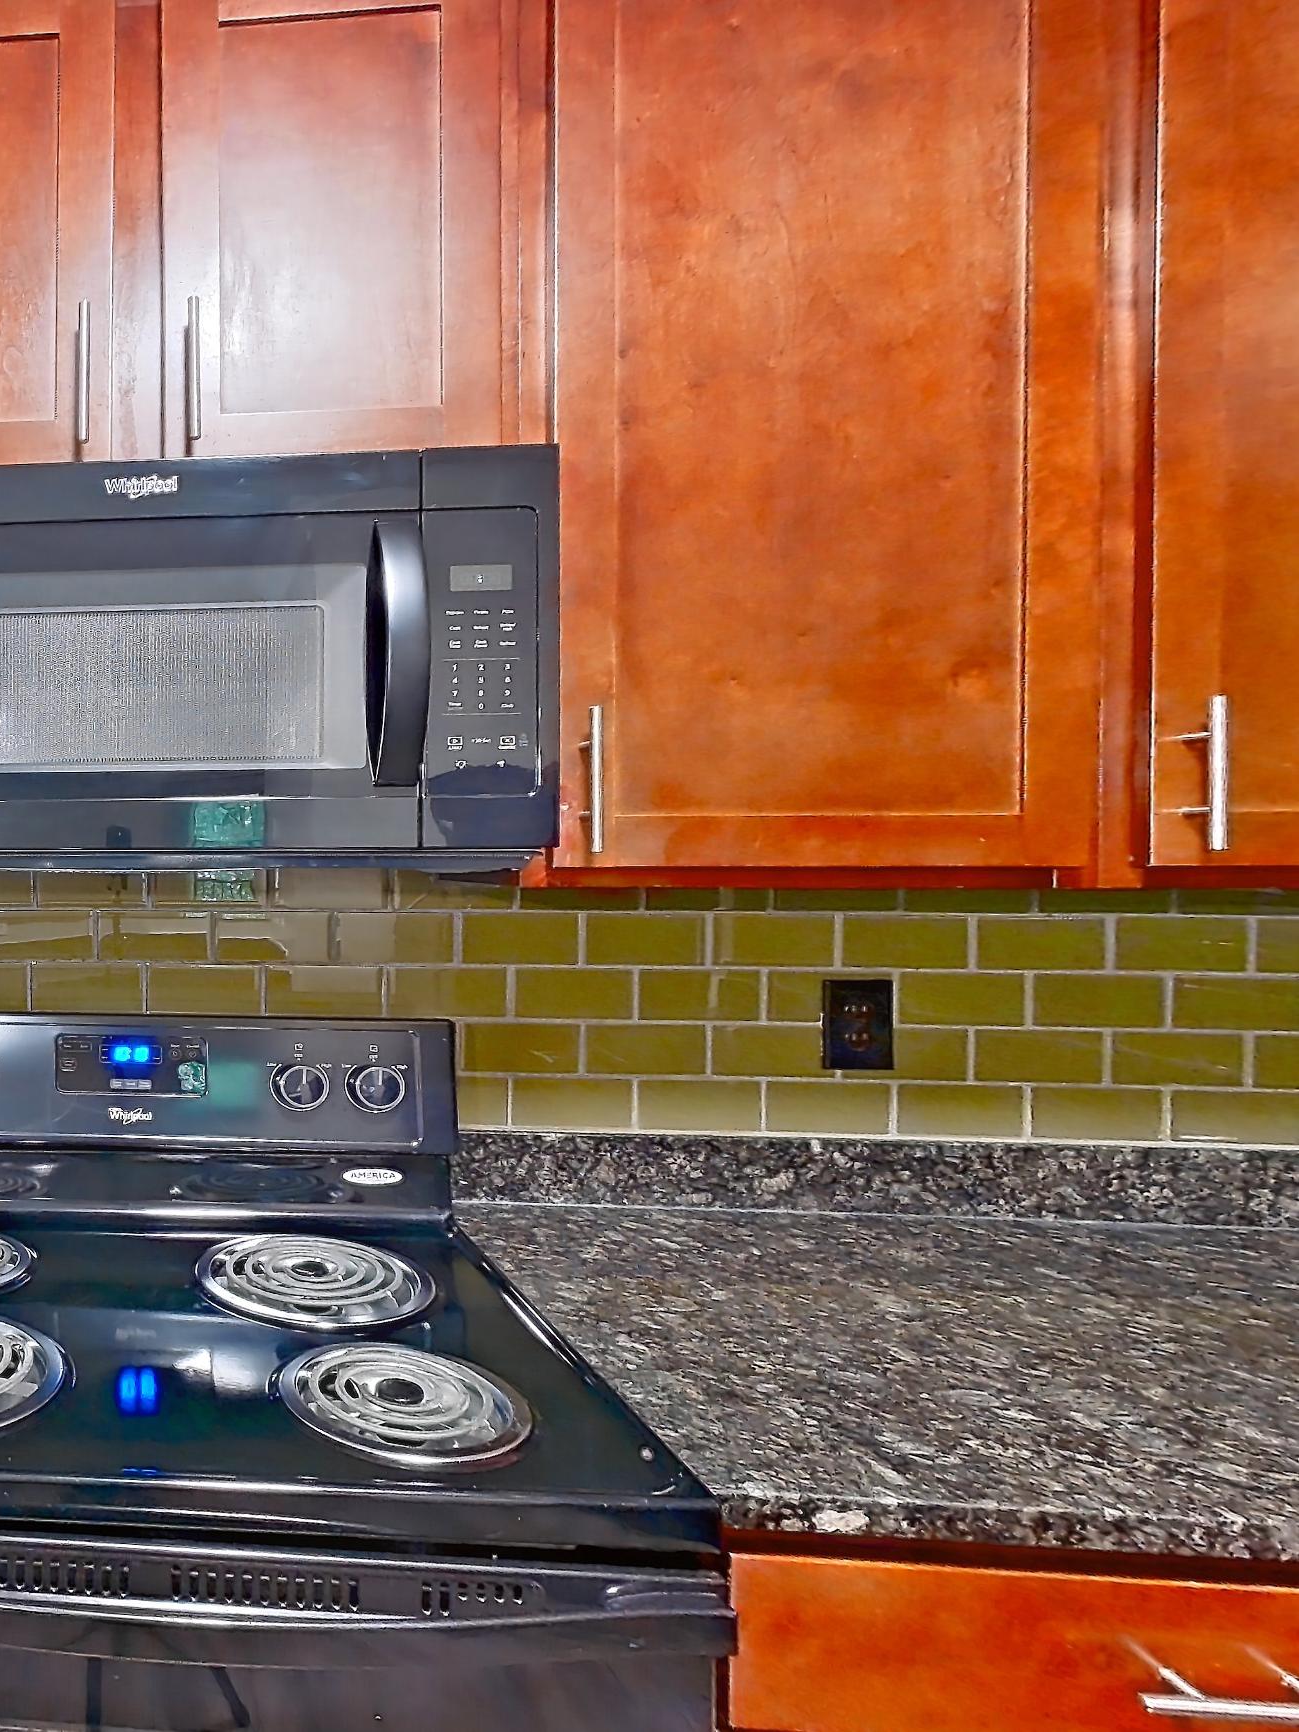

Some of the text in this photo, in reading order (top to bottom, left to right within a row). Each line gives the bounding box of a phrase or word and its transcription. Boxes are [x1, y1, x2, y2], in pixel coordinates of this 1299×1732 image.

[103, 475, 179, 500] Whirlpool
[477, 663, 485, 671] 2
[504, 663, 511, 671] 3
[451, 676, 458, 684] 4
[478, 689, 484, 697] 8
[504, 689, 511, 697] 9
[478, 702, 484, 710] 0
[108, 1106, 153, 1125] Whirlpool
[351, 1171, 396, 1179] AMERICA
